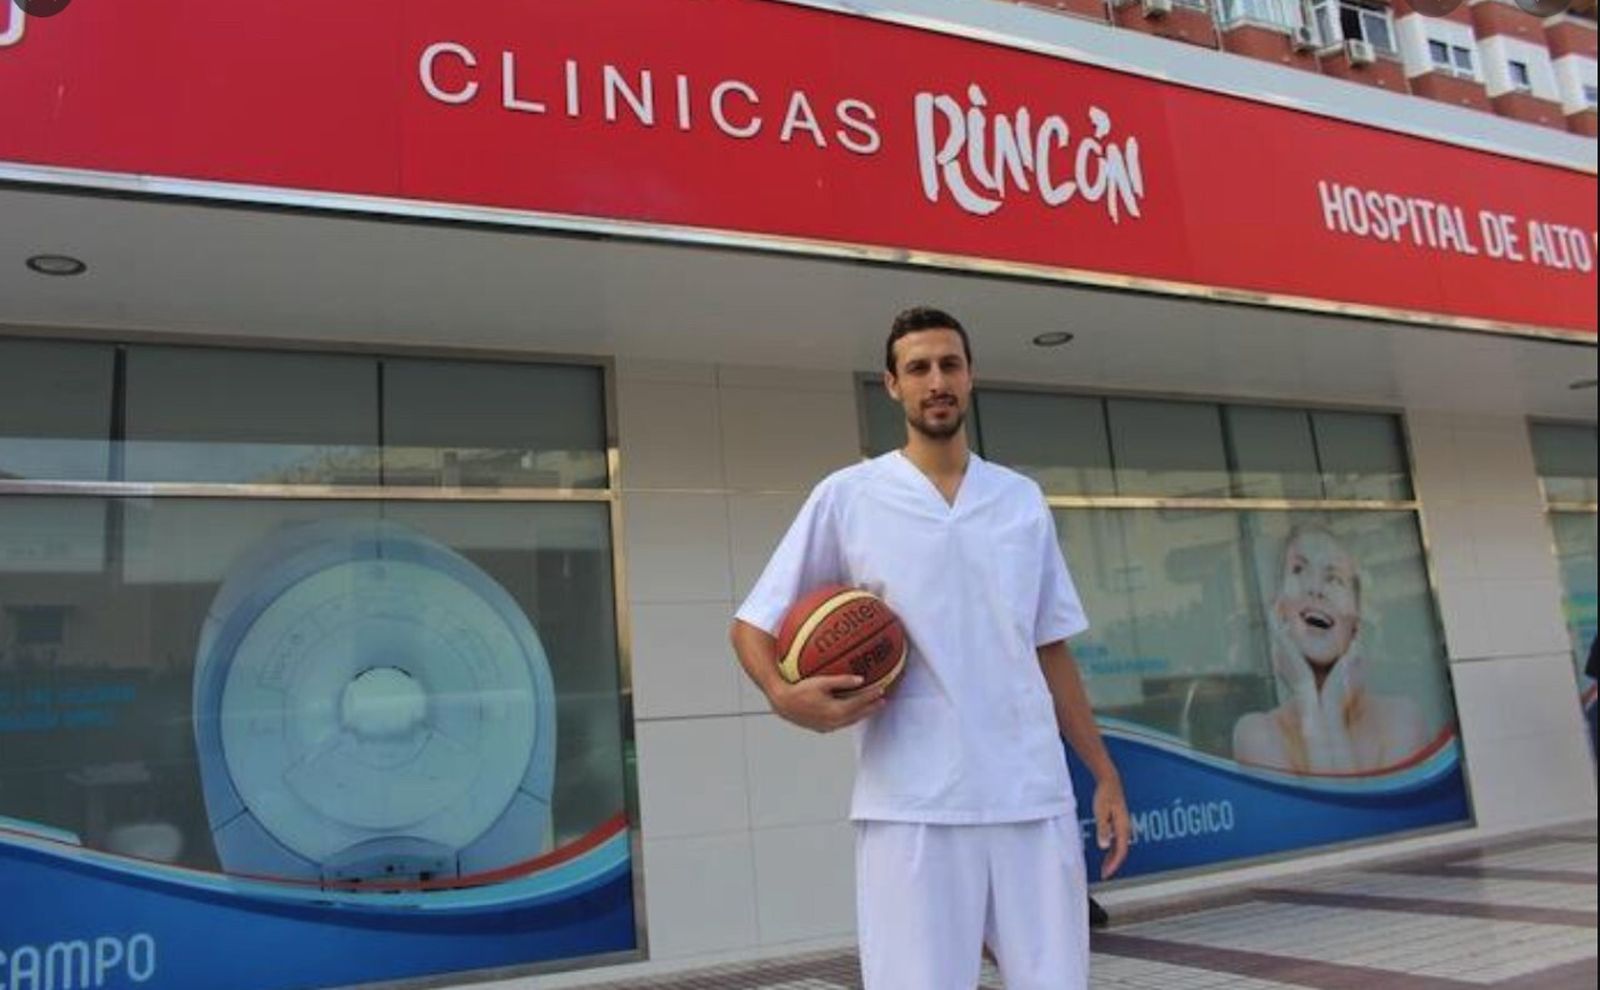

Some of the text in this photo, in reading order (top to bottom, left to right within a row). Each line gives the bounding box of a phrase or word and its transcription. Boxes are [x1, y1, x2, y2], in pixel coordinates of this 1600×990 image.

[418, 41, 881, 155] CLINICAS
[1317, 180, 1593, 273] HOSPITAL DE ALTO
